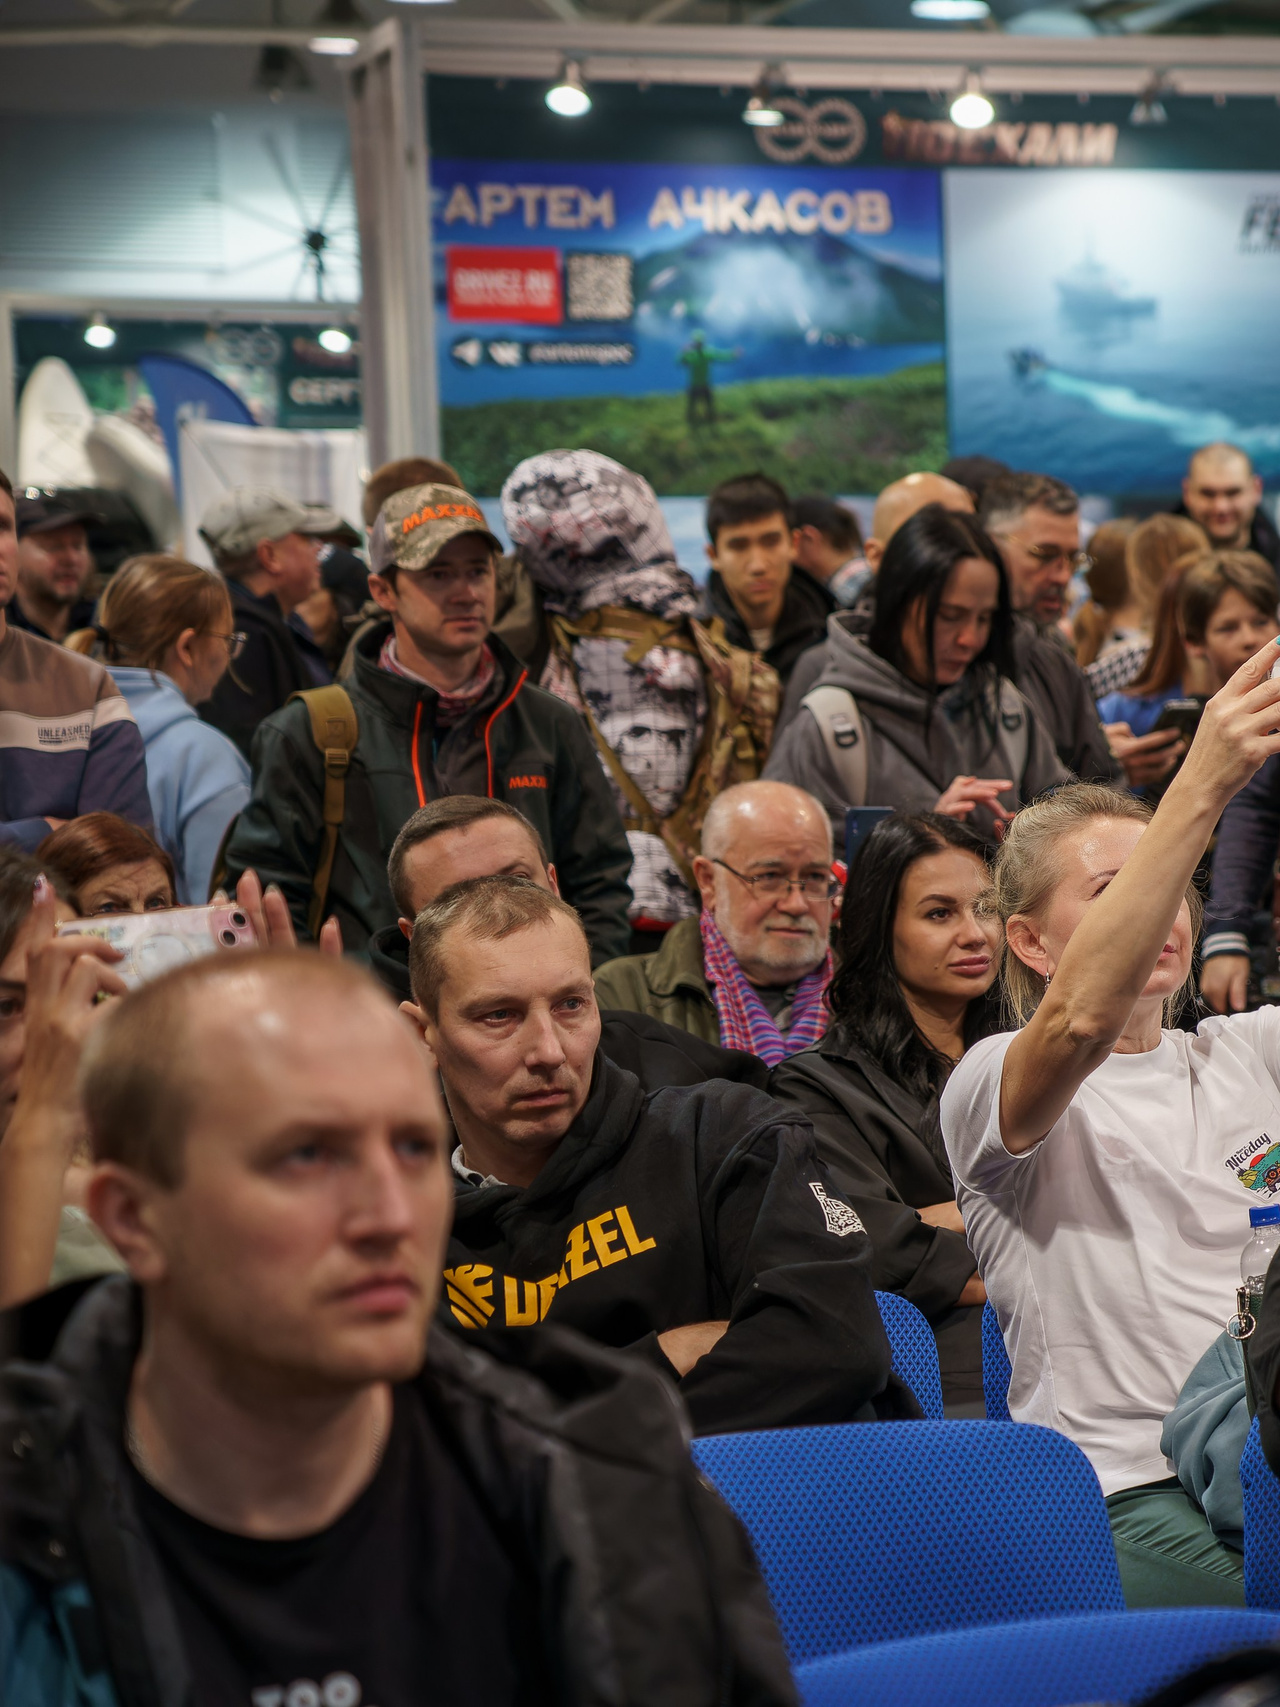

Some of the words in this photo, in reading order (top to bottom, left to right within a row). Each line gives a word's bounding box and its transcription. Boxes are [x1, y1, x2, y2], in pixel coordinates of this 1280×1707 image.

[443, 183, 616, 229] АРТЕМ
[647, 186, 892, 234] АЧКАСОВ
[1225, 1133, 1271, 1170] Niceday
